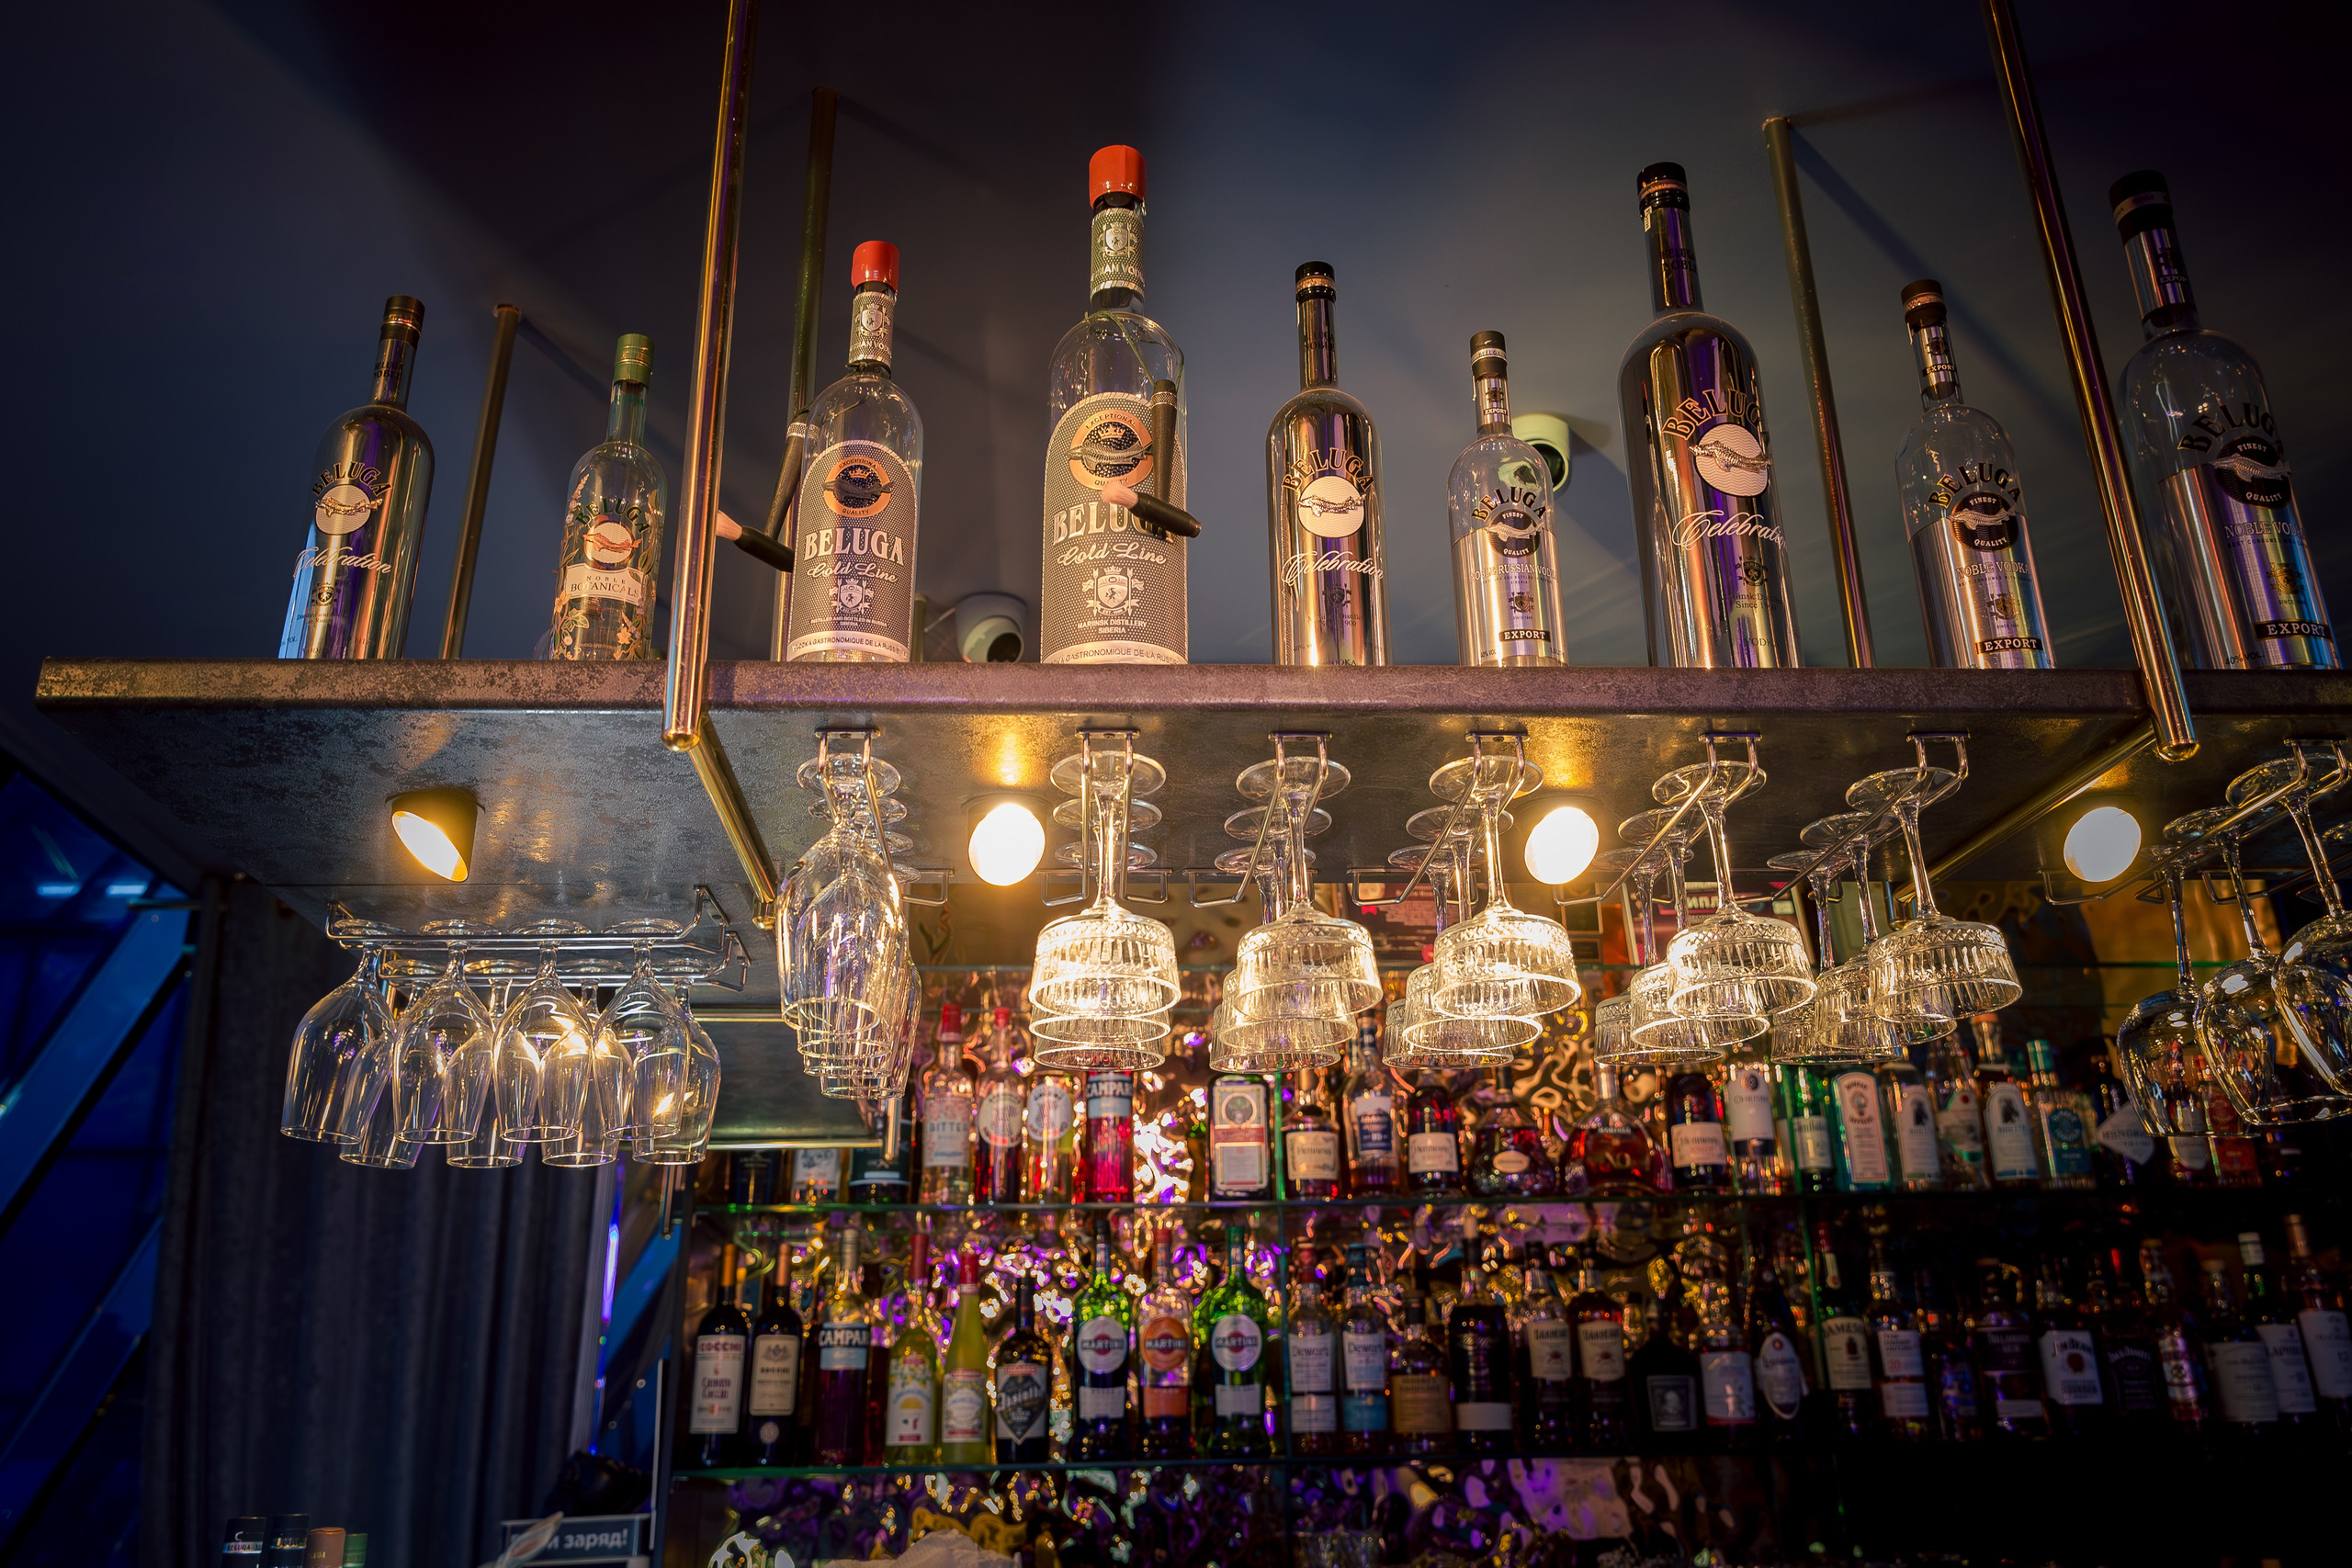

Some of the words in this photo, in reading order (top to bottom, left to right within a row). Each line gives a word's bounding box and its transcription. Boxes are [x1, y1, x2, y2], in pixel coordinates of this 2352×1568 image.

[1085, 413, 1136, 430] EXCEPTIONAL
[1662, 389, 1770, 447] BELUG
[2237, 443, 2267, 453] FINEST
[839, 458, 879, 469] EXCEPTIONAL
[1281, 447, 1375, 493] BELUGA
[312, 461, 392, 498] BELUGA
[1094, 477, 1129, 486] QUATY
[1928, 462, 2021, 509] BELUGA
[2245, 491, 2283, 502] QUALITY
[1471, 487, 1547, 523] BELUGA
[575, 497, 650, 534] BELUGA
[1053, 502, 1174, 546] BELUG
[2223, 521, 2272, 539] NOBLE
[804, 527, 904, 566] BELUGA
[1973, 536, 2008, 547] QUALITY
[1057, 546, 1110, 566] Gold
[1113, 542, 1167, 564] Line
[293, 546, 391, 579] Celebration
[1281, 549, 1384, 587] Celebration
[1498, 564, 1535, 574] RUSSIAN
[1956, 561, 1994, 580] NOBLE
[1996, 561, 2030, 574] VODKA
[586, 576, 626, 584] NOBLE
[808, 562, 853, 581] Gold
[856, 562, 899, 583] Line
[571, 582, 639, 598] BOTANICALS
[1078, 620, 1108, 630] MARIINSK
[1110, 619, 1148, 629] DISTILLERY
[2266, 623, 2325, 637] EXPORT
[1504, 630, 1546, 640] EXPORT
[1984, 638, 2038, 651] EXPORT
[1066, 649, 1132, 662] GASTRONOMIQUE
[1134, 649, 1144, 658] DE
[1146, 651, 1156, 660] LA
[2225, 655, 2243, 666] 40%
[2245, 651, 2266, 660] VOL.
[1081, 1338, 1124, 1349] MARTINI
[1145, 1338, 1187, 1348] MARTINI
[1215, 1336, 1258, 1347] MARTINI
[563, 1529, 628, 1551] заряд!
